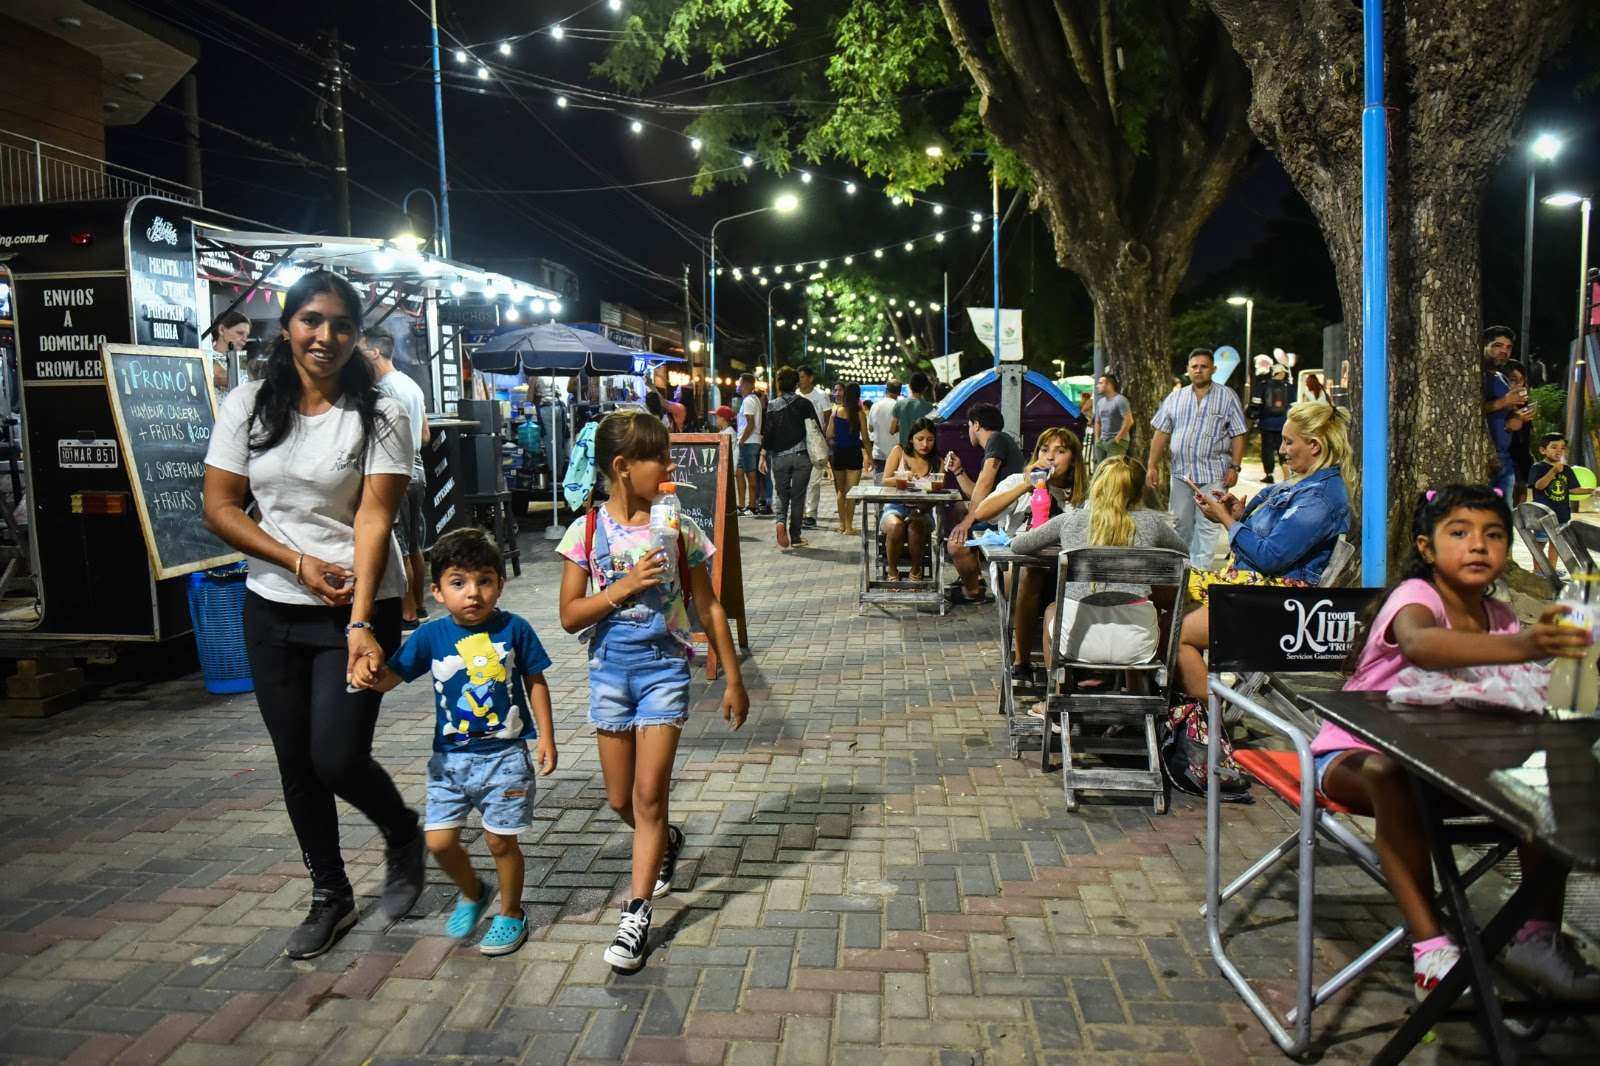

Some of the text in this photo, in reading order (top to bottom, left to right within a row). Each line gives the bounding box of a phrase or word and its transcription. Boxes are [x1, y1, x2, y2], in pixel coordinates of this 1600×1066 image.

[43, 288, 94, 307] ENVIOS
[63, 310, 73, 328] A
[153, 322, 179, 340] RUBIA
[39, 334, 107, 352] DOMICILIO
[96, 448, 115, 462] 851
[155, 461, 207, 480] SUPERPANC
[1286, 652, 1313, 660] Servicios
